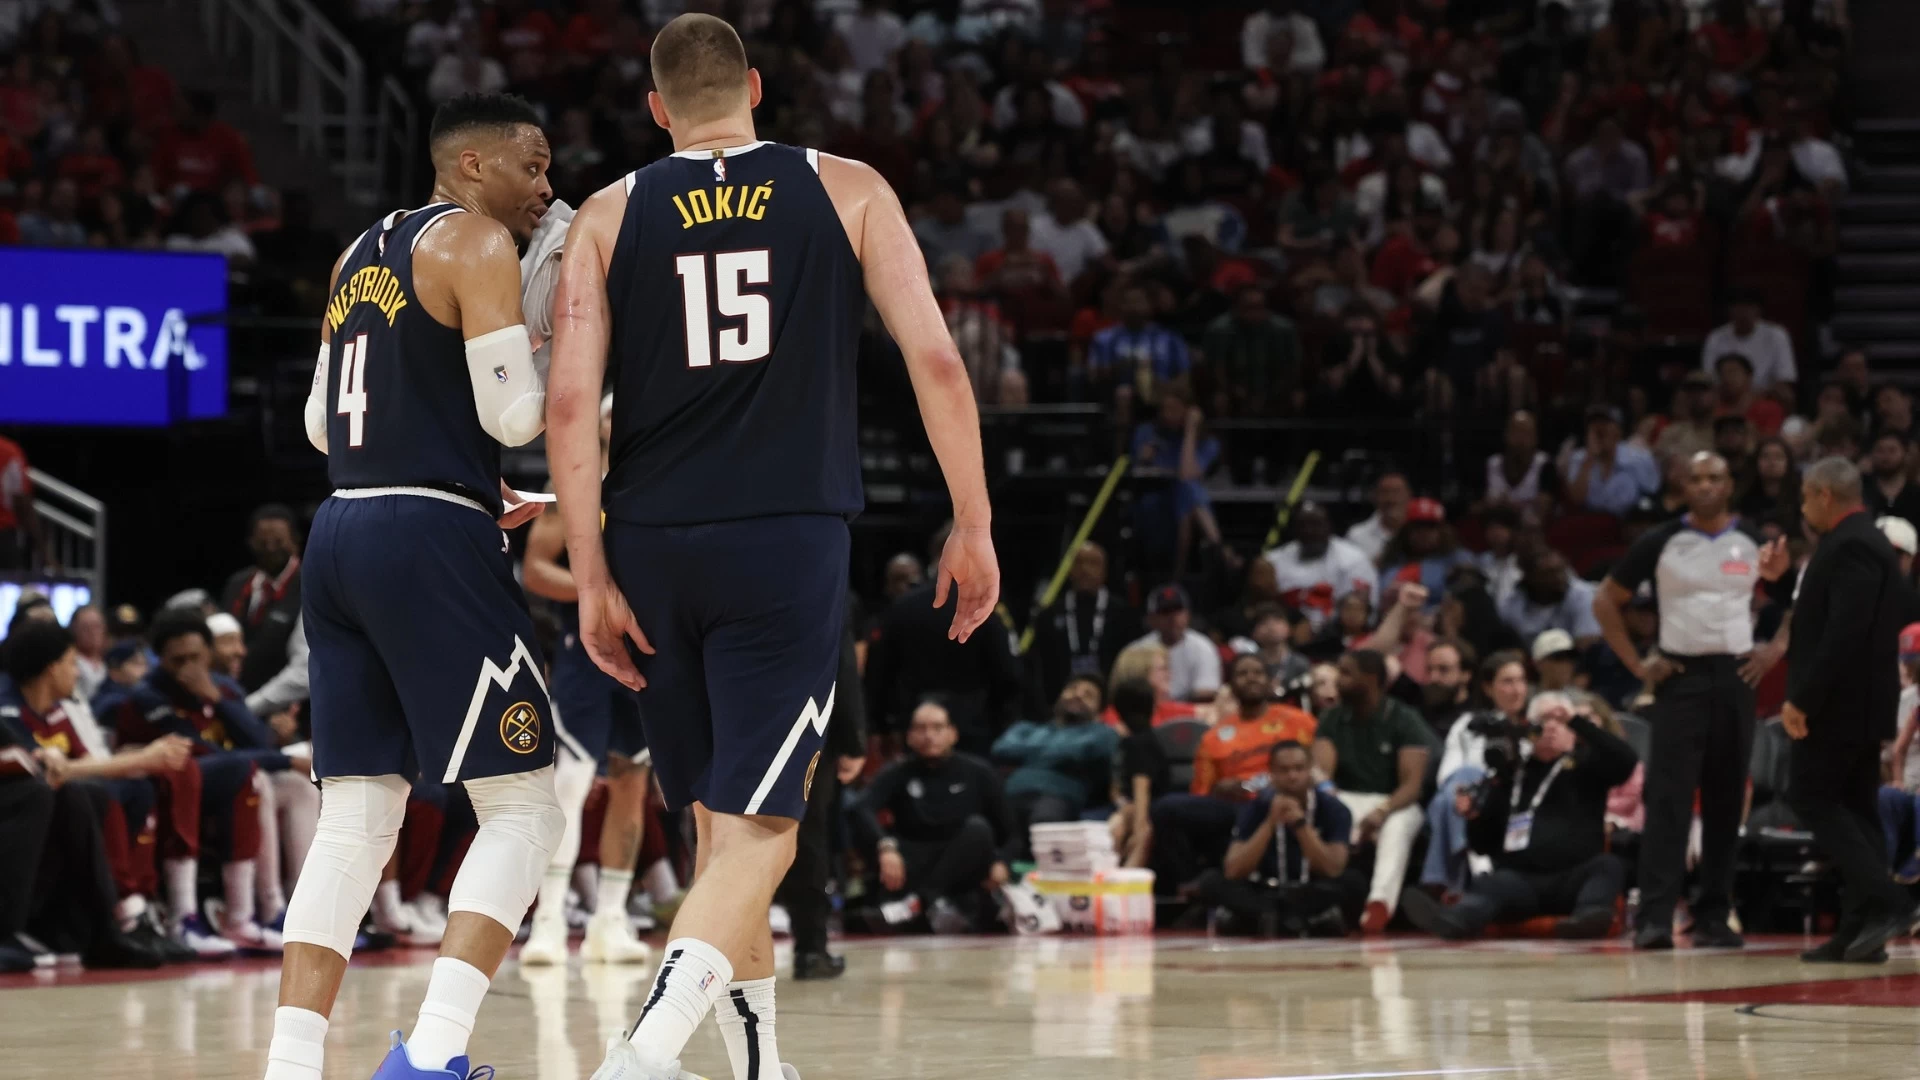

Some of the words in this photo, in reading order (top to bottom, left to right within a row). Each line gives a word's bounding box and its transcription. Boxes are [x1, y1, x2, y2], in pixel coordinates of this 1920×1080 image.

[672, 180, 773, 229] JOKIĆ
[327, 265, 407, 333] WESTBOOK
[674, 248, 771, 368] 15
[337, 332, 368, 448] 4
